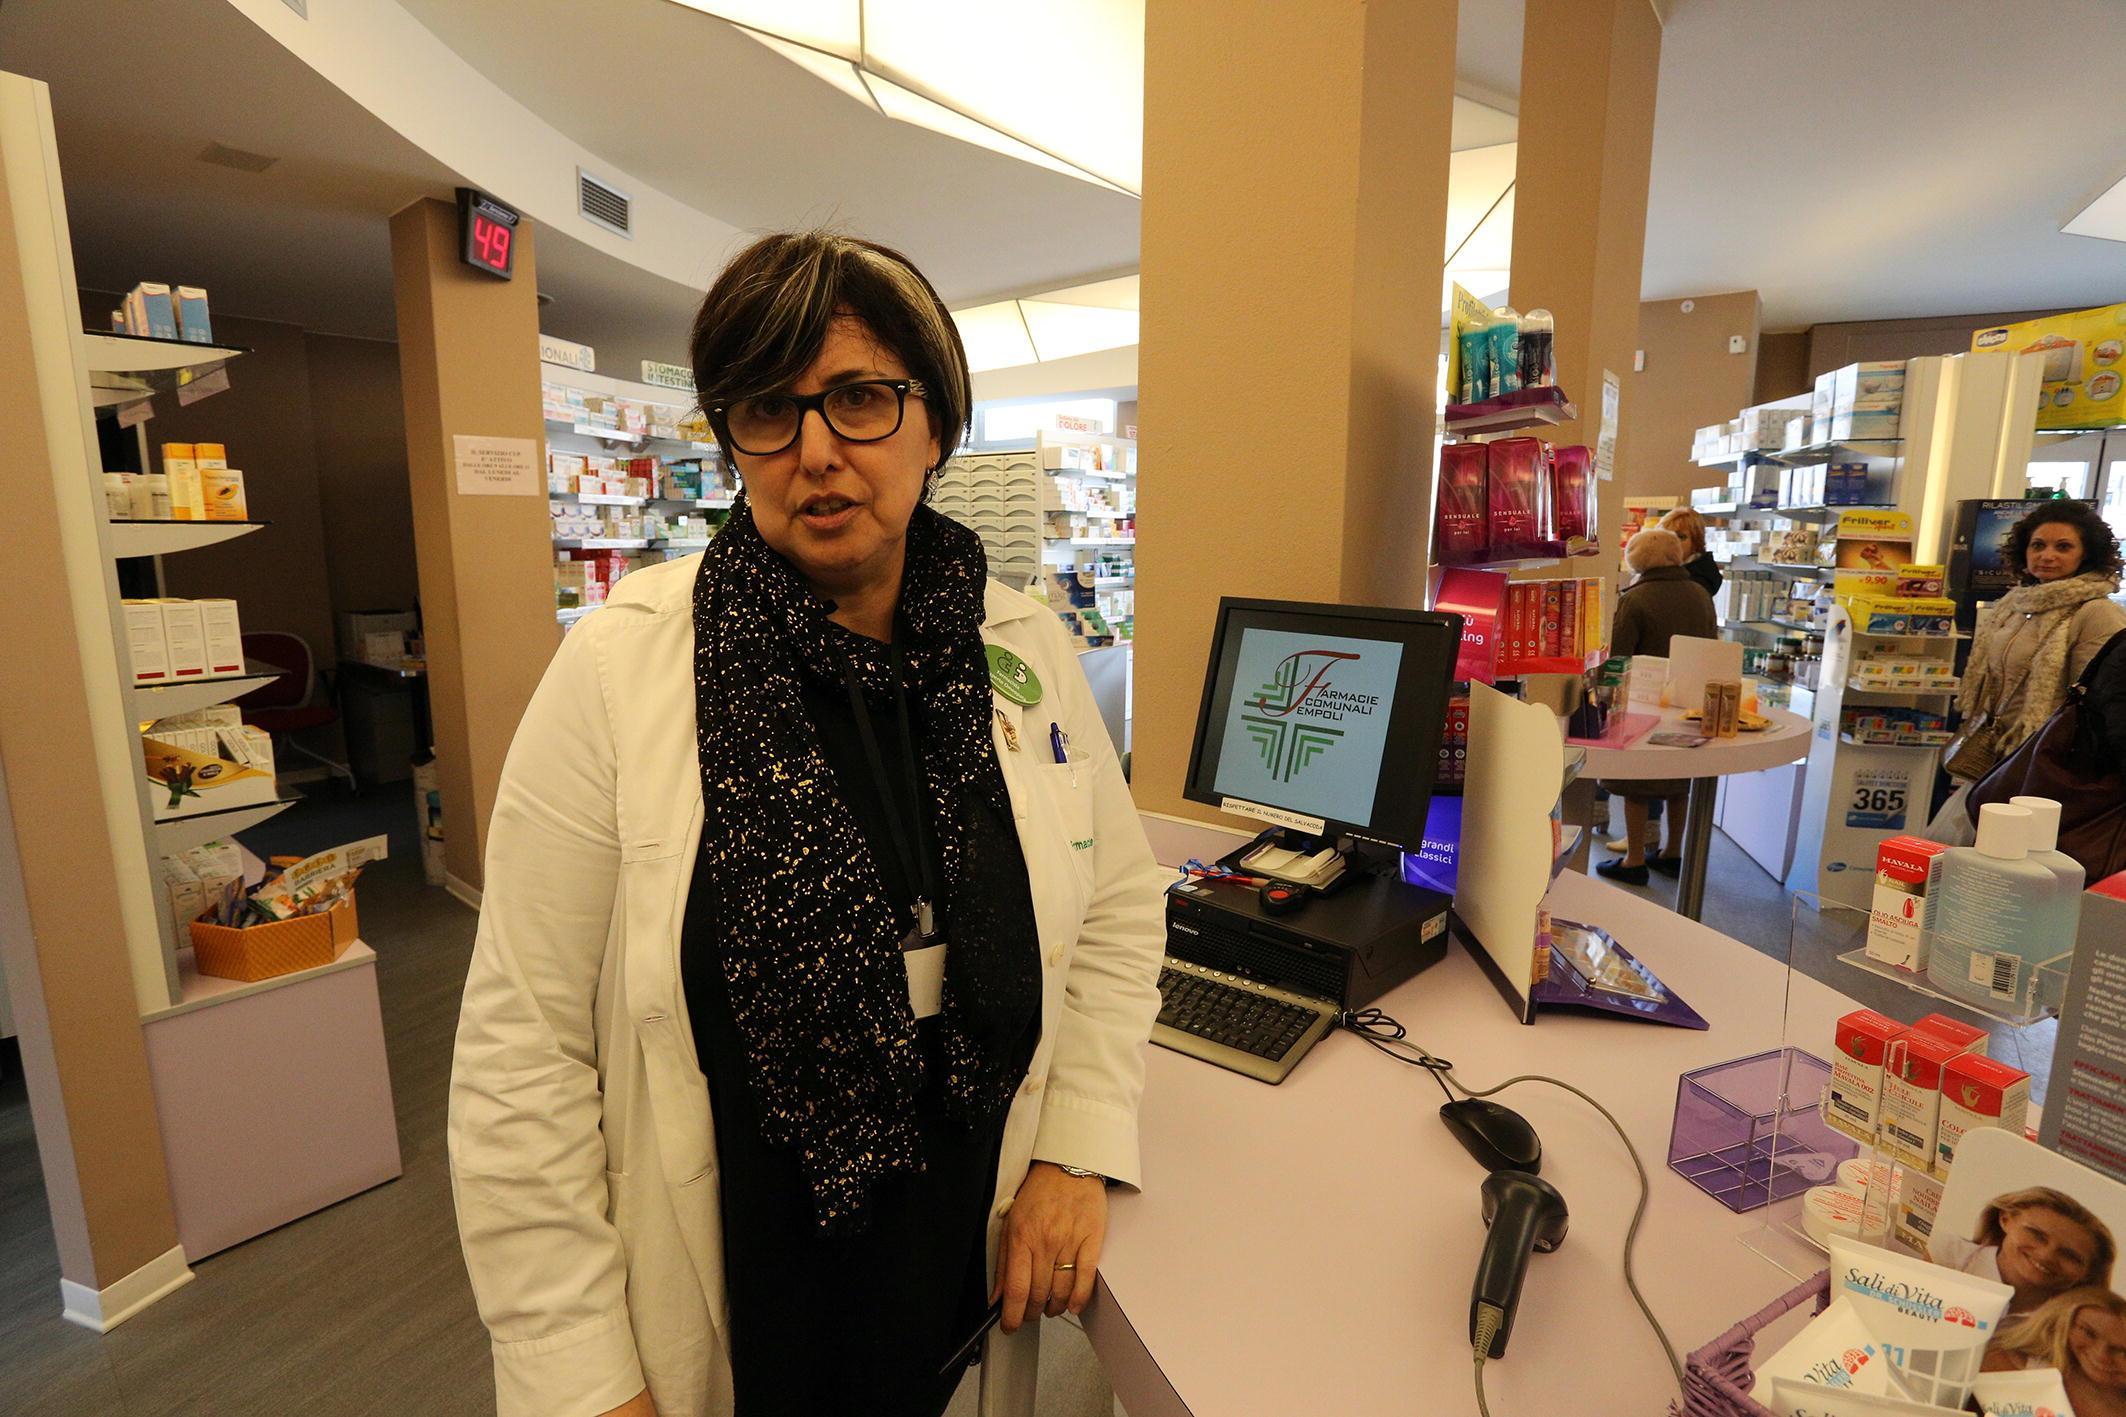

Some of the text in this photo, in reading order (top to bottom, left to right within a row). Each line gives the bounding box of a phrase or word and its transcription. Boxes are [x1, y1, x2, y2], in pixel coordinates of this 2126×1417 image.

[474, 214, 511, 270] 49
[541, 346, 578, 366] IONALI
[647, 363, 693, 380] STOMACO
[647, 373, 694, 390] INTESTIN
[1494, 509, 1531, 517] SENSUALE
[1842, 516, 1891, 527] Friliver
[1296, 706, 1344, 721] EMPOLI
[1305, 697, 1373, 716] COMUNALI
[1853, 788, 1905, 811] 365
[1223, 801, 1256, 814] RISPETTARE
[1263, 809, 1284, 821] NUMERO
[1284, 815, 1295, 823] DEL
[1421, 839, 1454, 853] grandi
[1882, 856, 1924, 873] MAVALA
[1172, 921, 1199, 936] lenovo
[1872, 915, 1898, 928] SMALTO
[1889, 914, 1919, 928] ASCIUGA
[1844, 1268, 1886, 1294] Sali
[1899, 1282, 1944, 1310] Vita
[1897, 1307, 1939, 1324] BEAUTY
[1803, 1358, 1842, 1384] Vita
